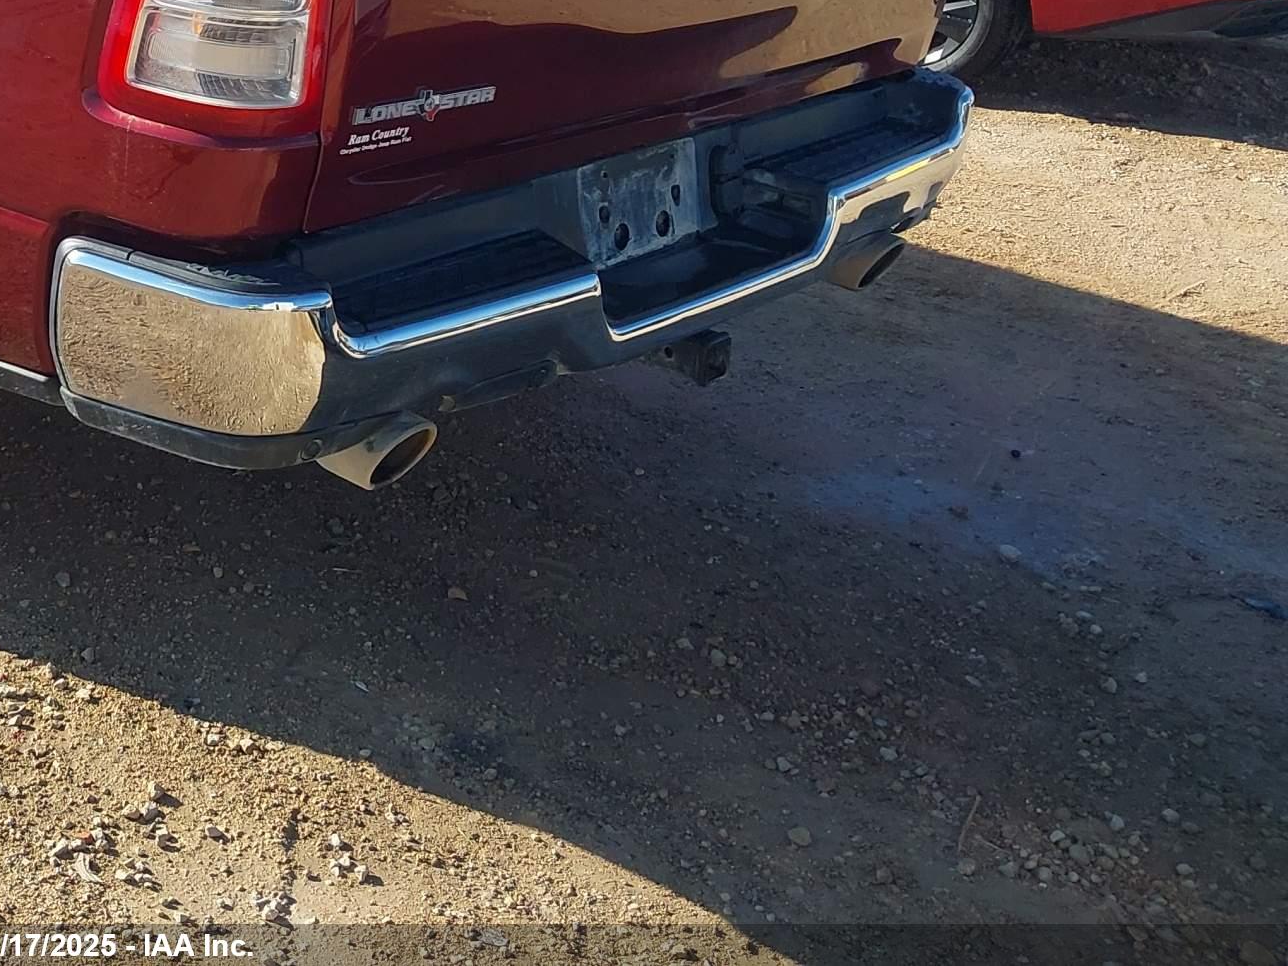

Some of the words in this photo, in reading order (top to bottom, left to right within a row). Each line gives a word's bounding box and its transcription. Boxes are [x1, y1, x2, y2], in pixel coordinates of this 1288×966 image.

[352, 100, 418, 125] LONE
[440, 87, 496, 110] STAR
[348, 133, 370, 145] Ram
[371, 127, 410, 141] Country
